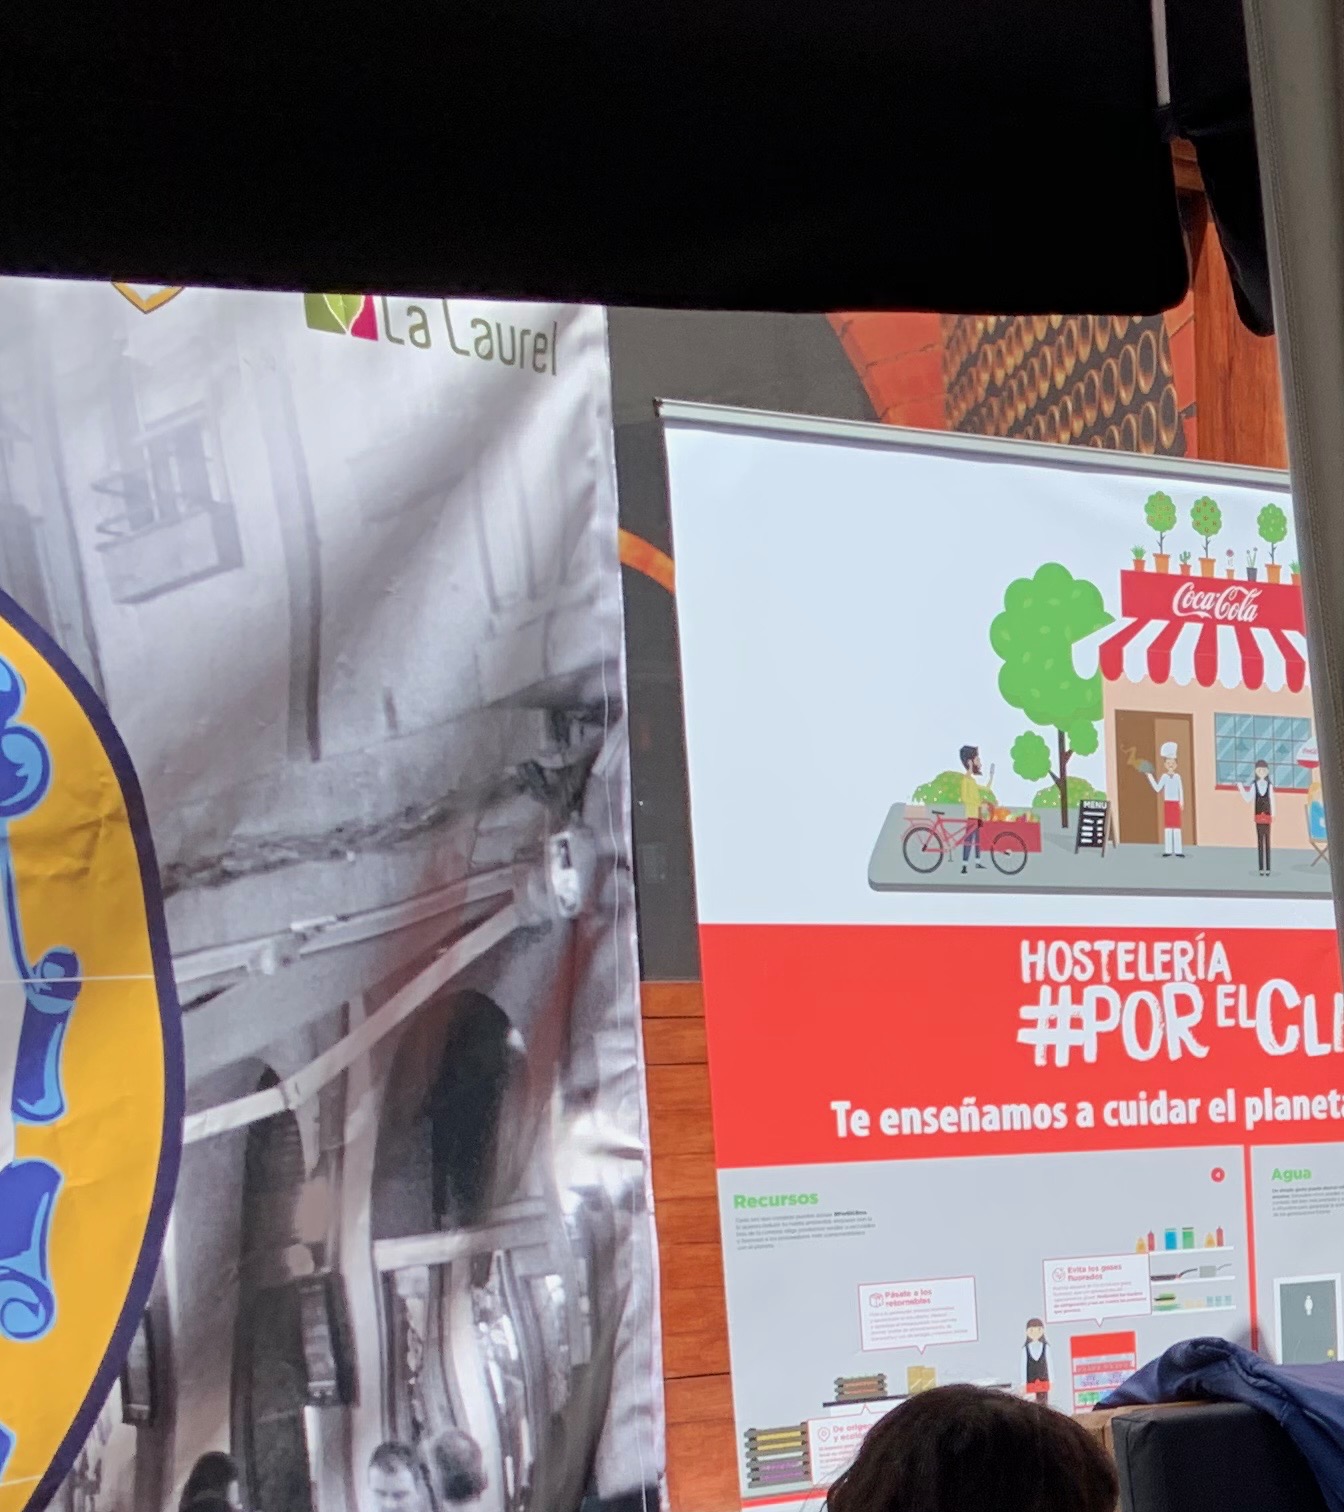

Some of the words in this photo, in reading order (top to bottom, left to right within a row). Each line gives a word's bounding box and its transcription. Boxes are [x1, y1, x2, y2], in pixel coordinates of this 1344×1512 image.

[381, 295, 431, 350] La
[442, 297, 557, 376] Laurel
[1172, 582, 1263, 622] Coca-Cola
[1083, 800, 1107, 810] MENU
[1020, 932, 1233, 984] HOSTELERÍA
[1016, 980, 1210, 1067] #POR
[1216, 984, 1257, 1028] EL
[830, 1101, 870, 1138] Te
[880, 1096, 1069, 1137] enseñamos
[1076, 1102, 1095, 1129] a
[1103, 1090, 1200, 1128] cuidar
[1208, 1088, 1236, 1124] el
[1271, 1167, 1312, 1183] Agua
[733, 1192, 819, 1209] Recursos
